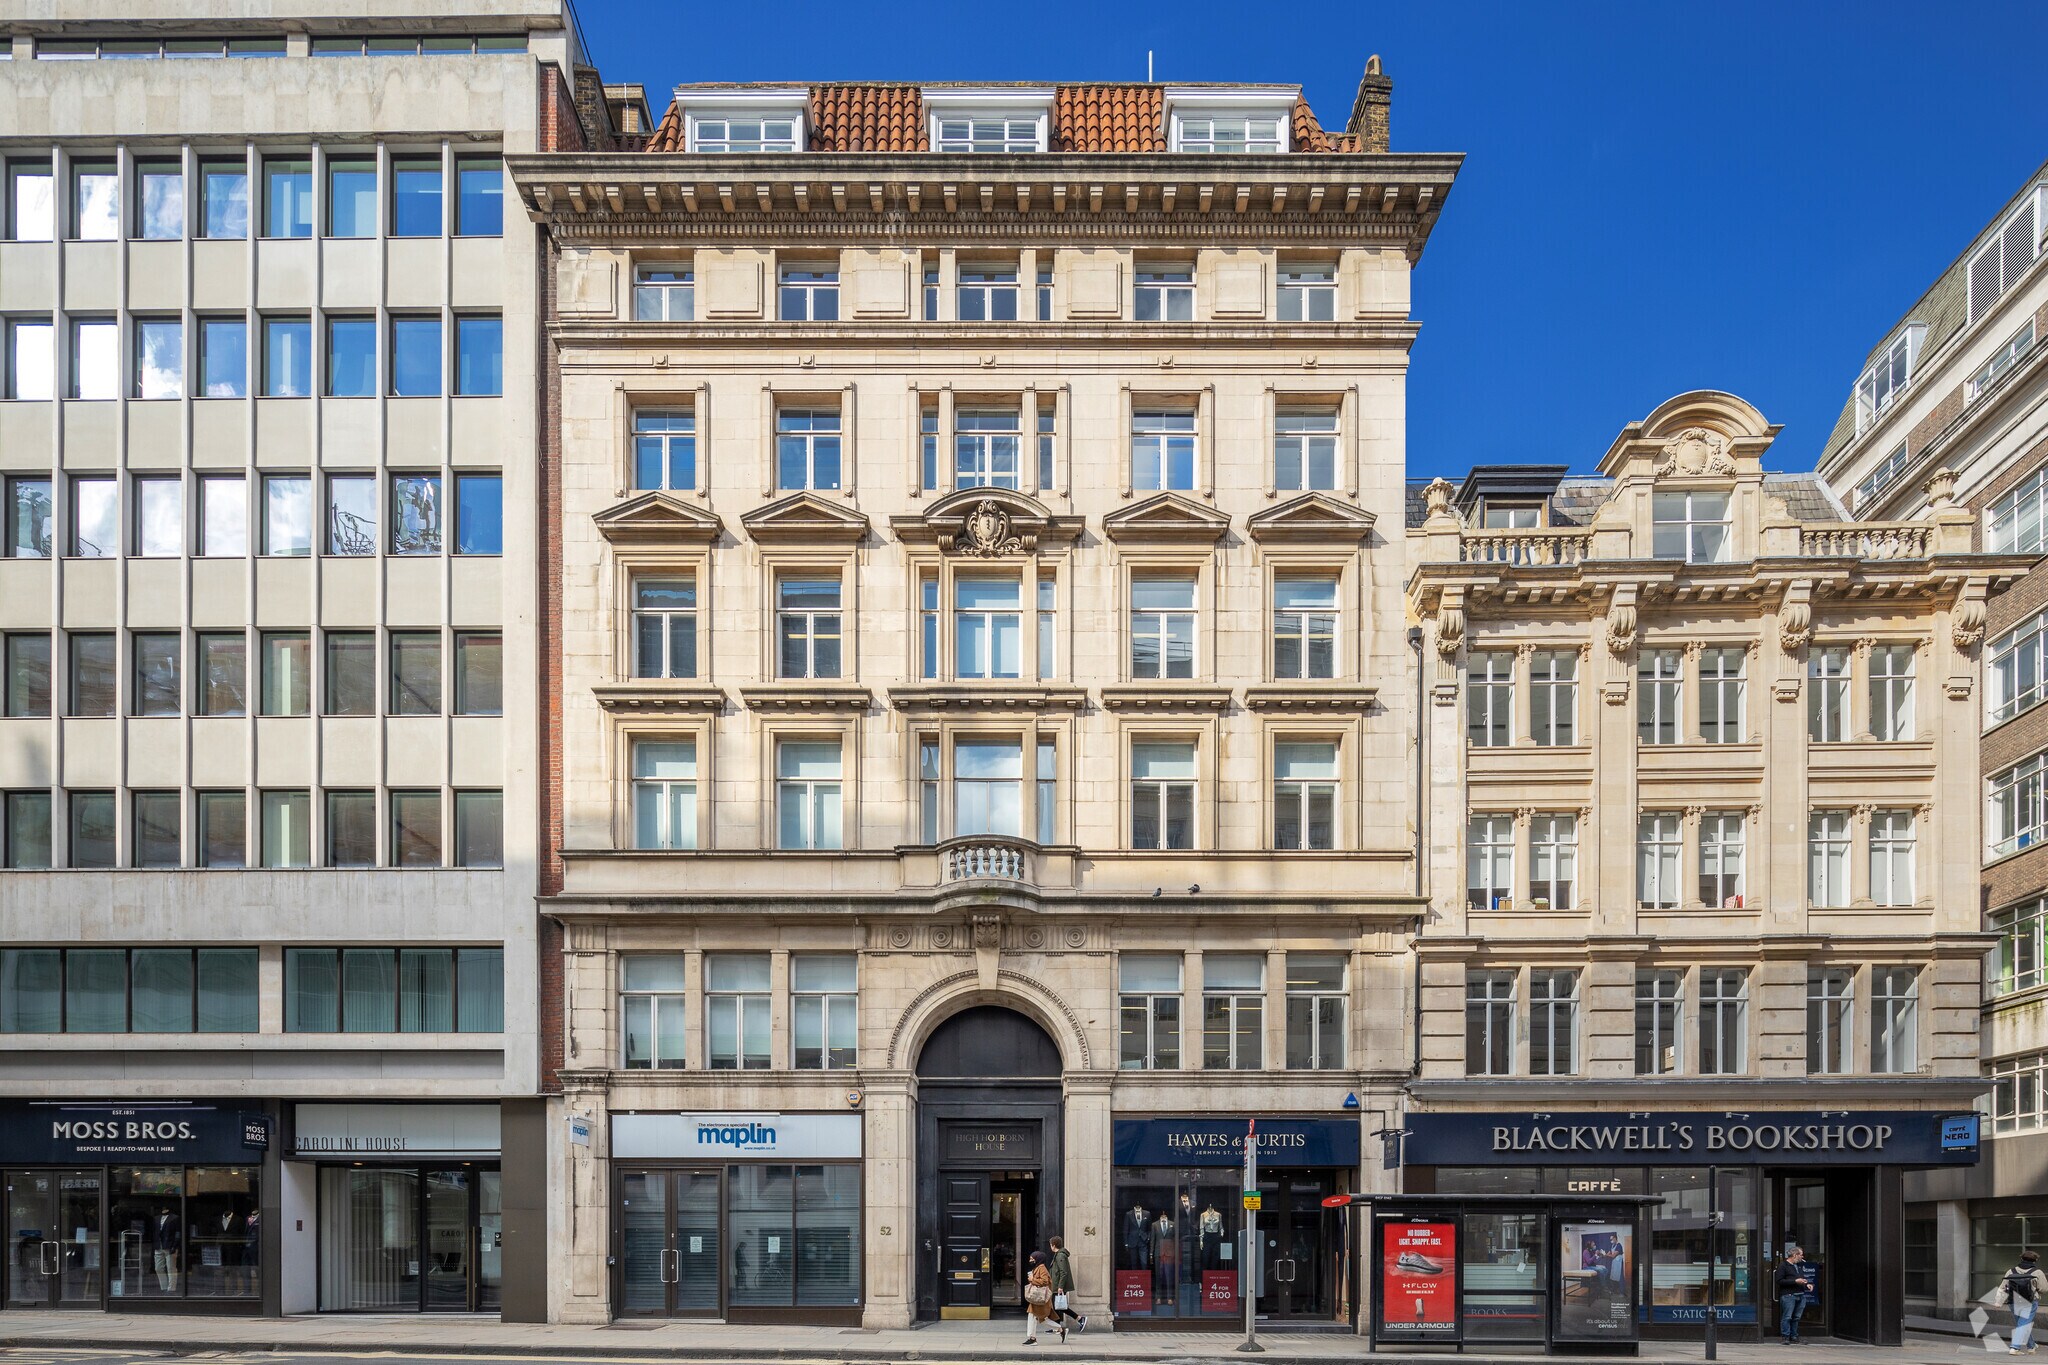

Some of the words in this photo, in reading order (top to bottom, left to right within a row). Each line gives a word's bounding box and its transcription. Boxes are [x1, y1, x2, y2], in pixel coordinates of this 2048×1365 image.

[53, 1122, 119, 1139] MOSS
[126, 1122, 197, 1139] BROS.
[246, 1125, 265, 1134] MOSS
[246, 1133, 267, 1142] BROS.
[698, 1122, 776, 1148] maplin
[955, 1134, 979, 1142] HIGH
[981, 1134, 1025, 1142] HOLBORN
[1492, 1121, 1694, 1151] BLACKWELL'S
[1706, 1124, 1893, 1150] BOOKSHOP
[1944, 1132, 1970, 1141] NERO
[296, 1137, 361, 1150] CAROLINE
[366, 1137, 408, 1150] HOUSE
[1167, 1133, 1228, 1147] HAWES
[1231, 1136, 1242, 1147] &
[1256, 1133, 1305, 1147] URTIS
[975, 1143, 1005, 1151] HOUSE
[1568, 1178, 1621, 1192] CAFFÈ
[880, 1226, 892, 1236] 52
[1084, 1226, 1096, 1236] 54
[1407, 1229, 1414, 1237] NO
[1412, 1238, 1430, 1246] SNAPPY.
[1430, 1238, 1442, 1246] FAST.
[1211, 1283, 1217, 1291] 4
[1124, 1289, 1145, 1298] £149
[1209, 1291, 1231, 1299] £100
[1471, 1308, 1508, 1316] BOOKS
[1672, 1309, 1736, 1319] STATIOERY
